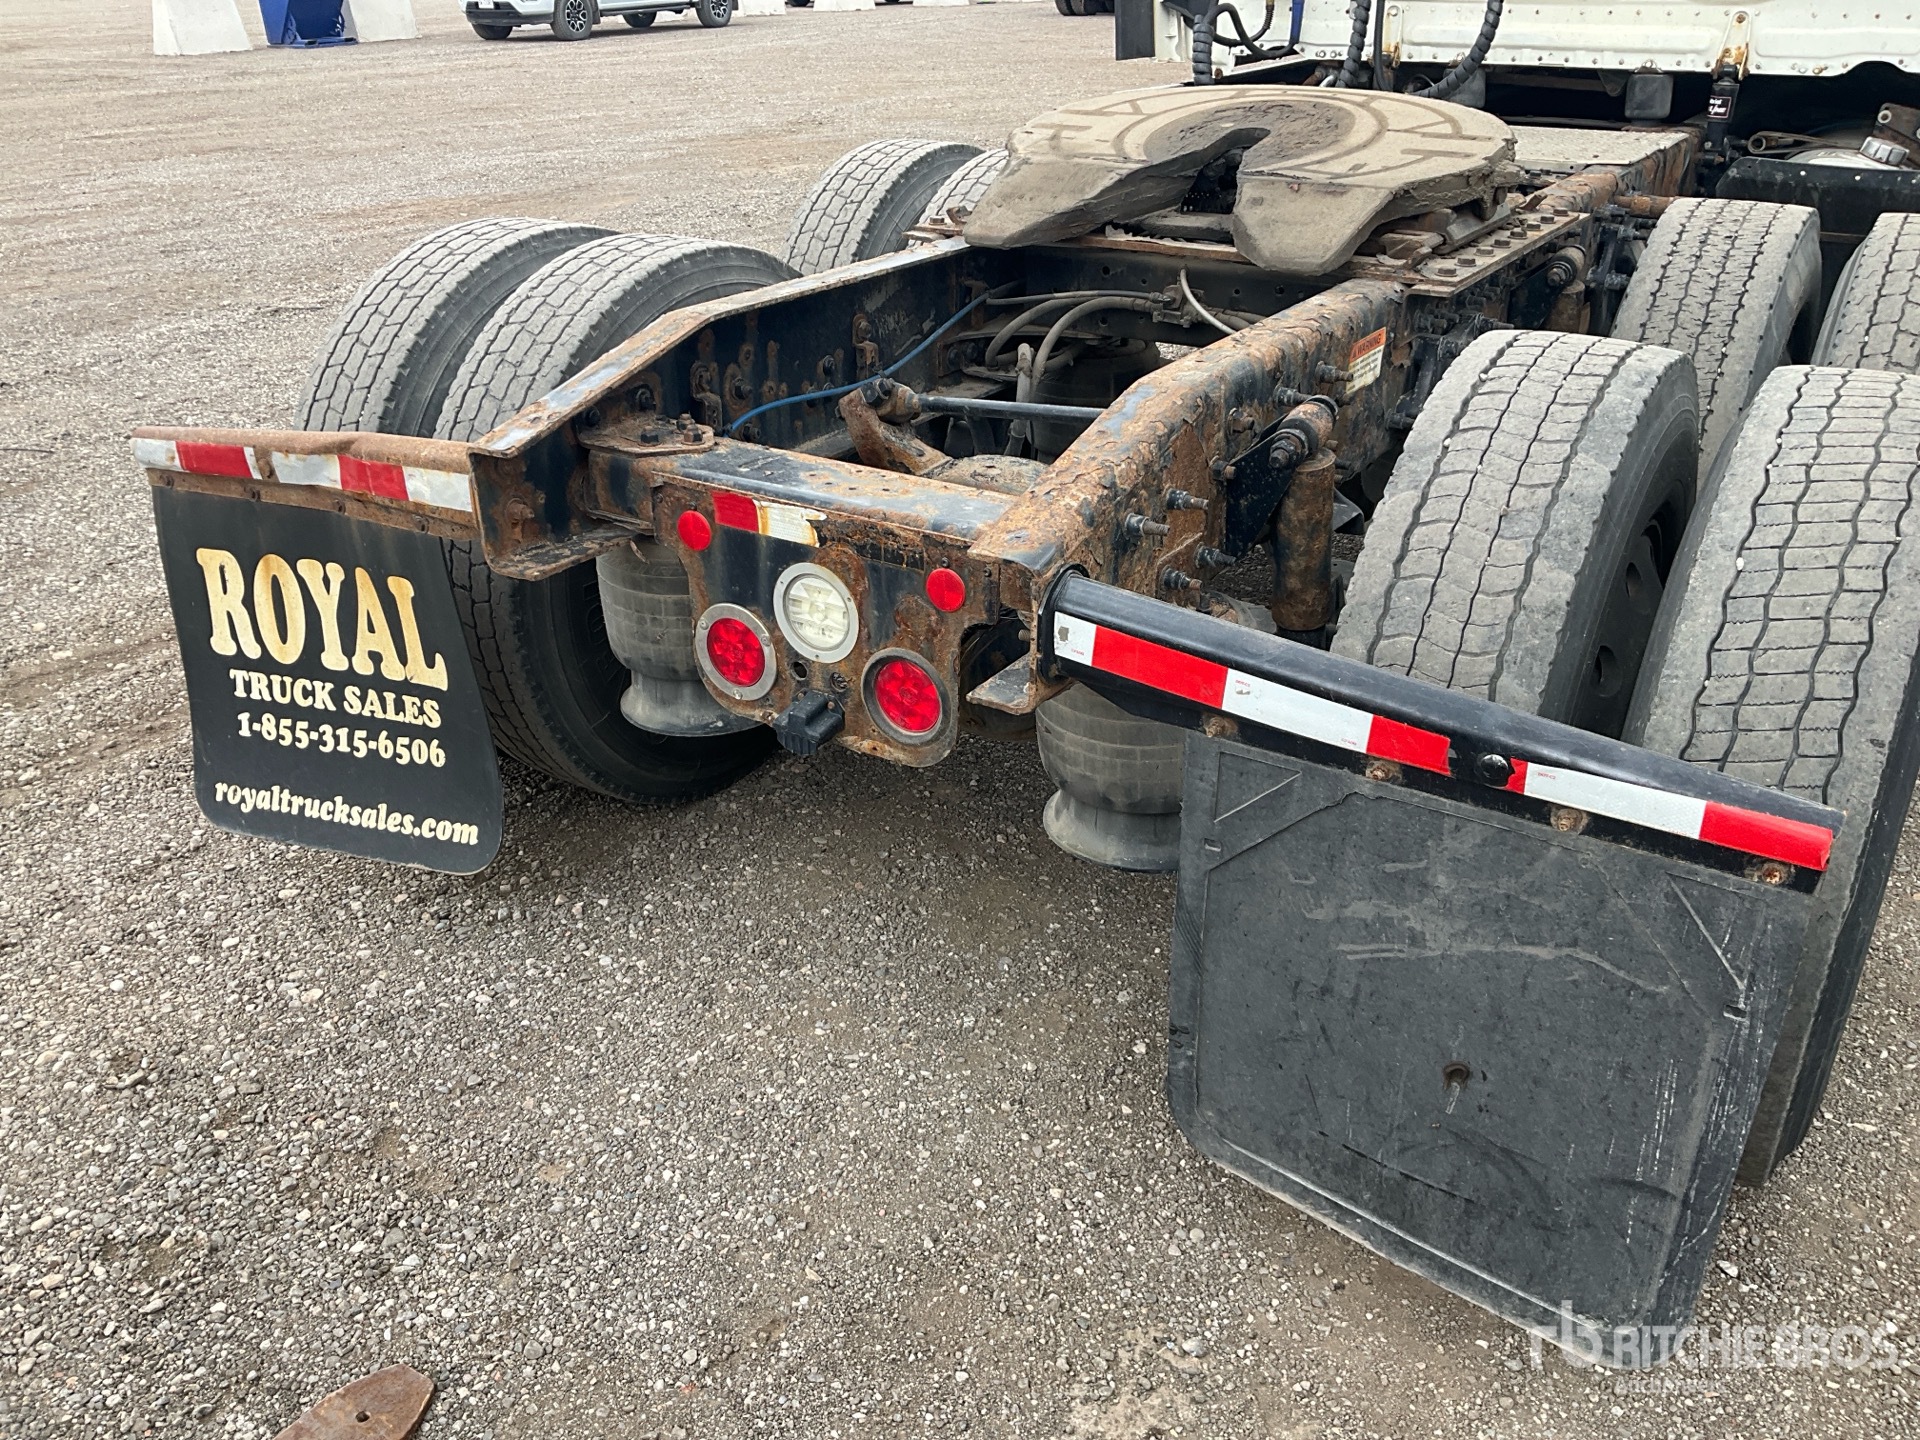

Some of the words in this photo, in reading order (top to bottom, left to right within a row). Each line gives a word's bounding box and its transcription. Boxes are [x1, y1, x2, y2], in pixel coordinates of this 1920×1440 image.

[196, 547, 448, 691] ROYAL
[229, 668, 337, 712] TRUCK
[343, 685, 442, 729] SALES
[237, 712, 446, 768] 1-855-315-6506
[214, 780, 479, 846] royaltrucksales.com
